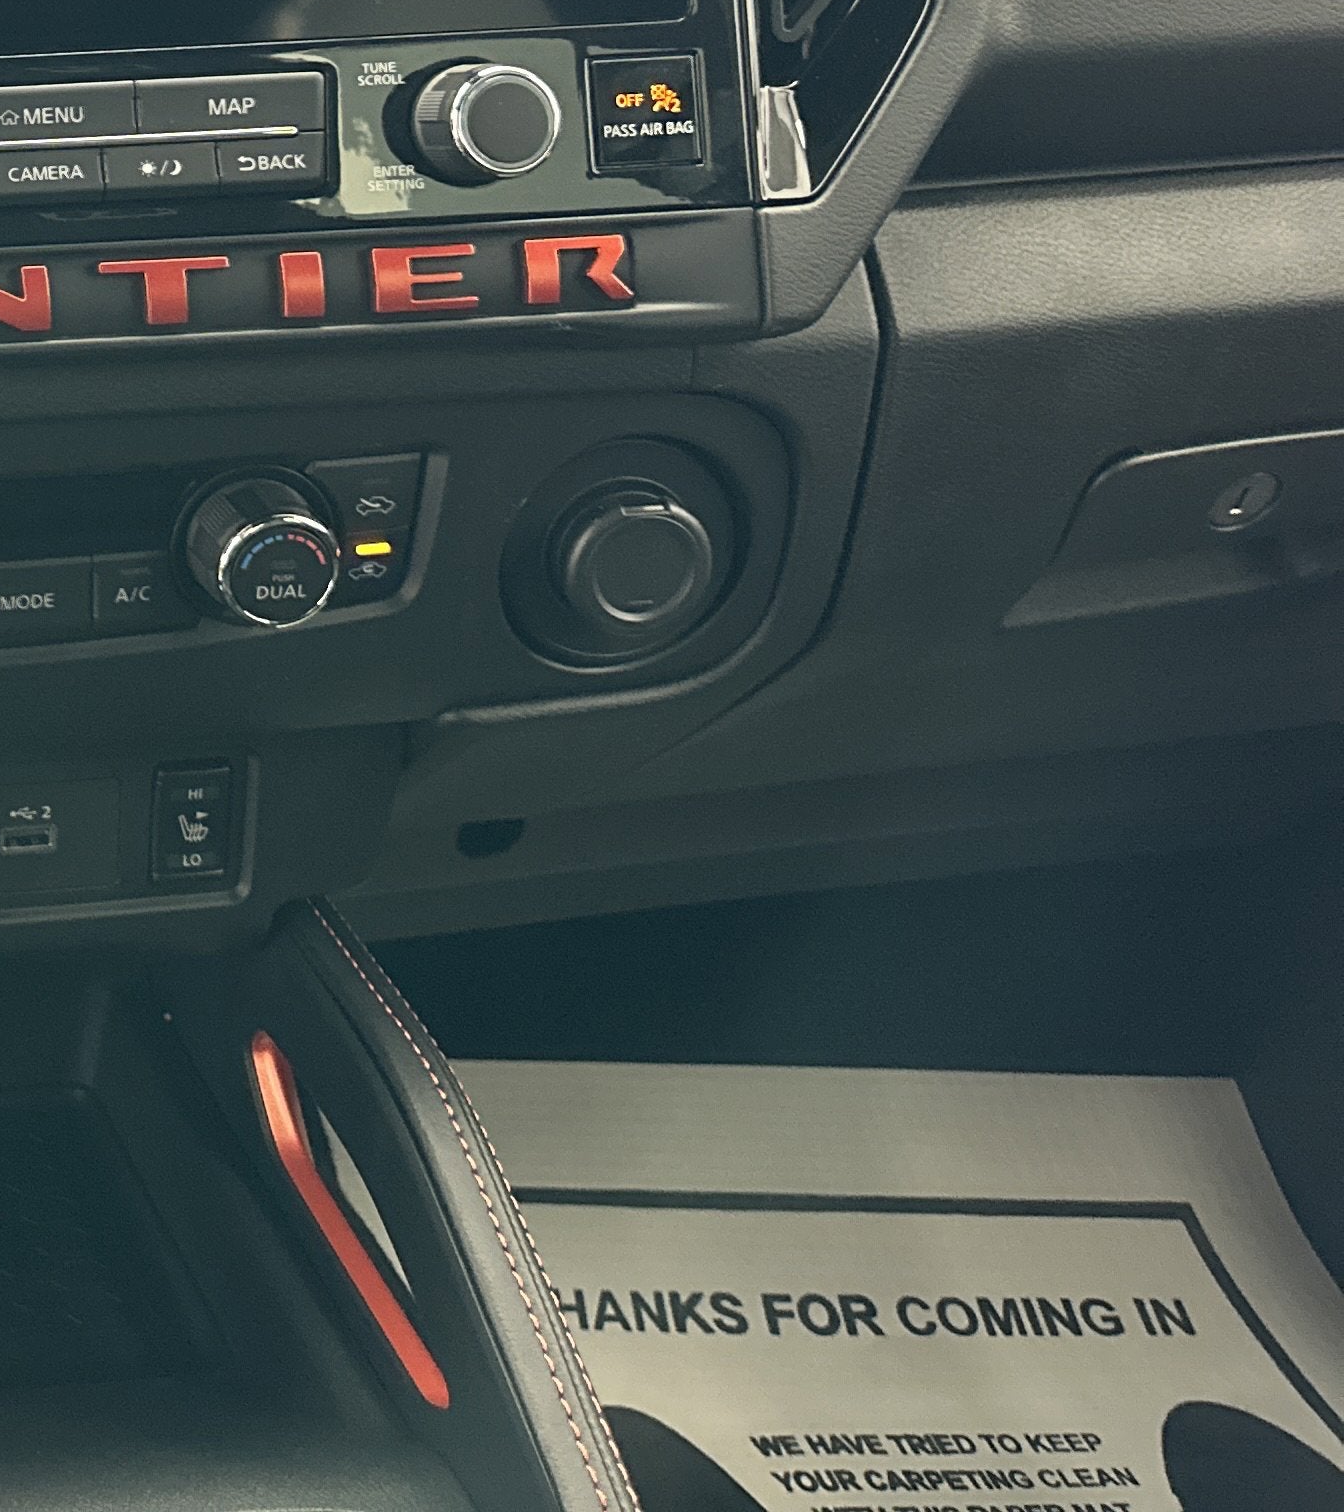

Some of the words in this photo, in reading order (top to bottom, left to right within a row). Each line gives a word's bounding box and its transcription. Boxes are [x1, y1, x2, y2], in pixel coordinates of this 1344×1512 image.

[361, 61, 397, 74] TUNE
[357, 74, 406, 86] SCROLL
[209, 97, 256, 116] MAP
[615, 93, 645, 108] OFF
[23, 106, 84, 125] MENU
[603, 123, 637, 138] PASS
[640, 122, 664, 136] AIR
[665, 120, 694, 135] BAG
[257, 154, 306, 171] BACK
[8, 164, 84, 183] CAMERA
[373, 165, 416, 178] ENTER
[367, 178, 425, 191] SETTING
[115, 585, 151, 604] A/C
[256, 584, 306, 600] DUAL
[0, 593, 55, 611] MODE
[188, 788, 203, 800] HI
[182, 854, 202, 867] LO
[550, 1288, 749, 1334] HANKS
[761, 1292, 885, 1337] FOR
[896, 1296, 1125, 1337] COMING
[1133, 1297, 1197, 1337] IN
[750, 1433, 805, 1457] WE
[806, 1433, 889, 1457] HAVE
[886, 1433, 977, 1456] TRIED
[978, 1433, 1022, 1455] TO
[1025, 1433, 1102, 1454] KEEP
[770, 1470, 863, 1493] YOUR
[864, 1470, 1034, 1492] CARPETING
[1037, 1467, 1140, 1489] CLEAN
